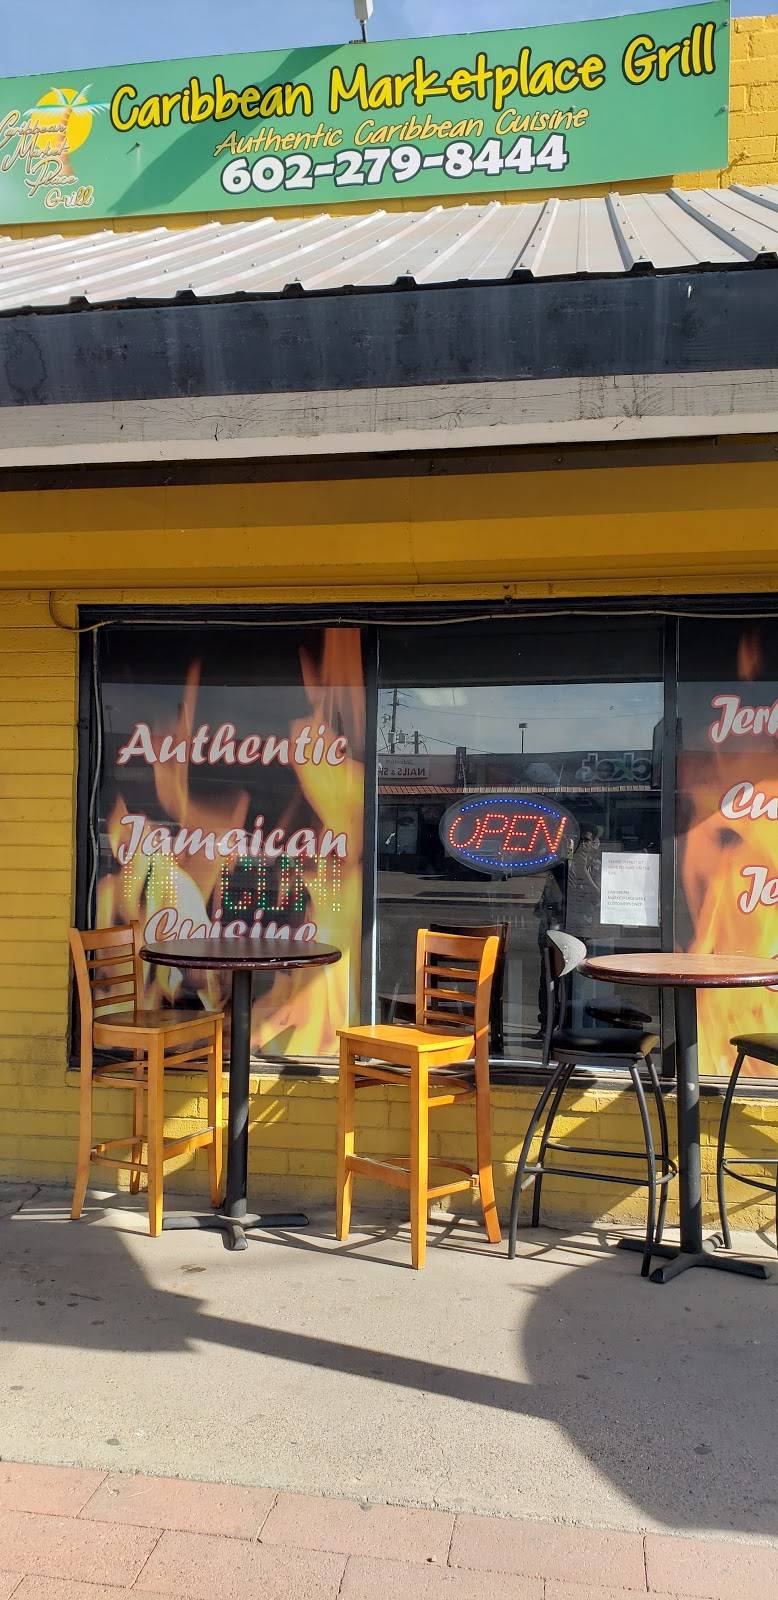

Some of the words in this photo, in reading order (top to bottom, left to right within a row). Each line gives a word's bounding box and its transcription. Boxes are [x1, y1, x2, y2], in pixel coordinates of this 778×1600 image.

[110, 74, 313, 132] Caribbean
[328, 46, 606, 111] Marketplace
[622, 21, 717, 85] Grill
[213, 122, 343, 157] Authentic
[354, 114, 483, 146] Caribbean
[495, 106, 590, 135] Cuisine
[2, 132, 70, 175] Market
[220, 134, 568, 195] 602-279-8444
[24, 157, 78, 197] Place
[45, 186, 95, 209] Grill
[116, 722, 348, 766] Authentic
[117, 814, 348, 866] Jamaican
[449, 812, 568, 853] OPEN
[143, 908, 319, 943] Cuisine
